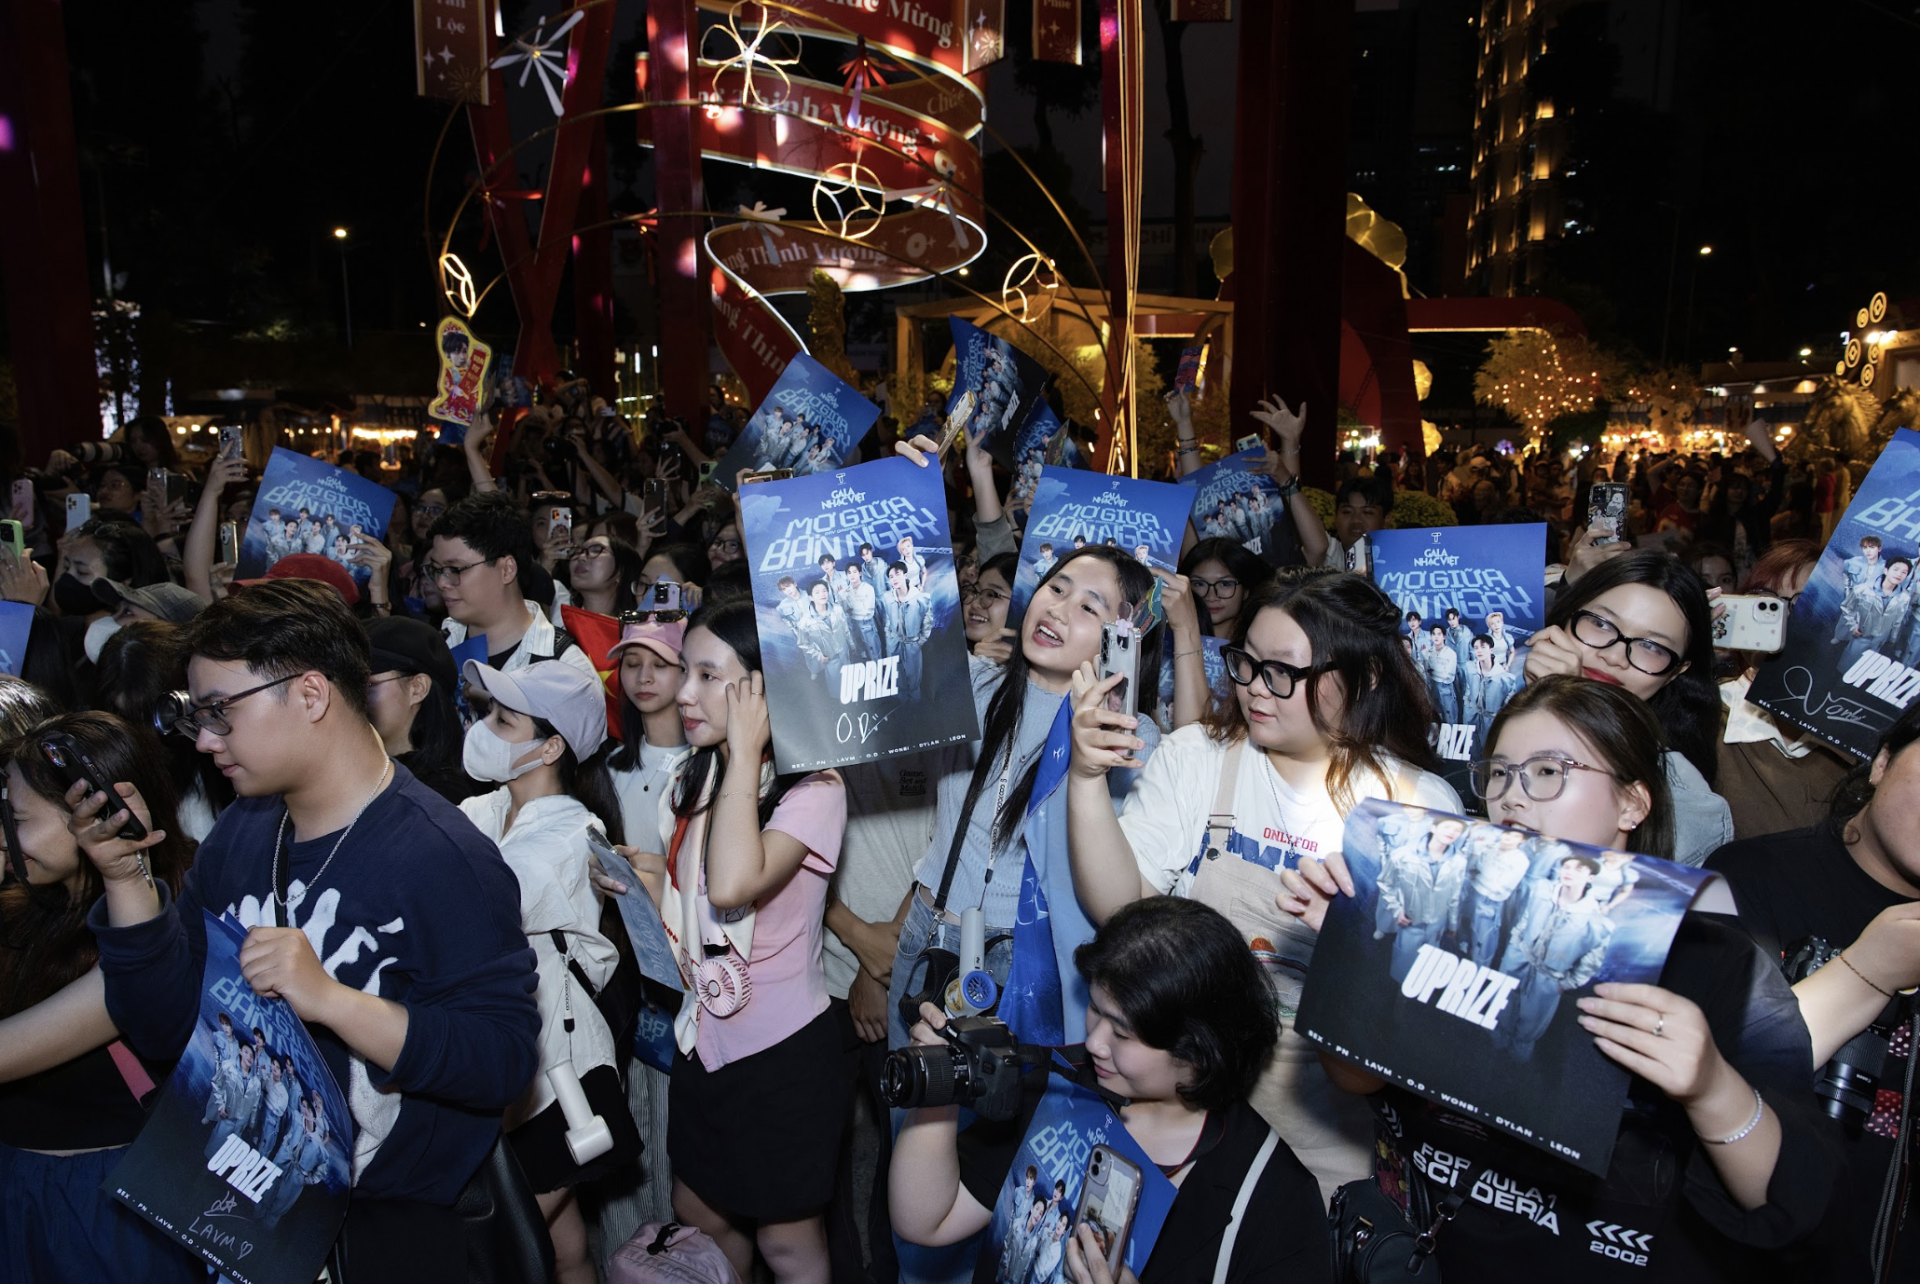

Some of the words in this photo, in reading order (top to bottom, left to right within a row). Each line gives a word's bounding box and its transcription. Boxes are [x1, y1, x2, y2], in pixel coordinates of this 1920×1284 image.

[886, 4, 953, 49] Mừng
[830, 103, 920, 155] Vượng
[742, 319, 787, 376] Thịn
[831, 486, 855, 499] GALA
[785, 510, 836, 538] MƠ
[839, 496, 916, 528] GIỮA
[1424, 548, 1448, 557] GALA
[1380, 571, 1426, 590] MƠ
[1429, 568, 1511, 589] GIỮA
[840, 655, 900, 705] UPRIZE
[919, 739, 940, 748] DYLAN
[949, 733, 967, 742] LEON
[1780, 710, 1790, 719] PN
[1798, 720, 1818, 733] LAVM
[1827, 735, 1840, 745] O.D
[1263, 827, 1293, 845] ONLY
[1294, 837, 1319, 853] FOR
[1401, 943, 1520, 1031] UPRIZE
[1335, 1045, 1349, 1057] PN
[1364, 1058, 1392, 1077] LAVM
[1406, 1078, 1425, 1091] O.D
[1440, 1092, 1479, 1113] WONBI
[1495, 1115, 1533, 1138] DYLAN
[1550, 1140, 1581, 1160] LEON
[207, 1132, 283, 1204] UPRIZE
[137, 1202, 148, 1213] PN
[155, 1215, 173, 1231] LAVM
[181, 1233, 194, 1245] O.D
[201, 1248, 225, 1267] WONBI
[232, 1270, 252, 1284] DYLA
[188, 1216, 236, 1251] LAVM
[1589, 1240, 1648, 1267] 2002
